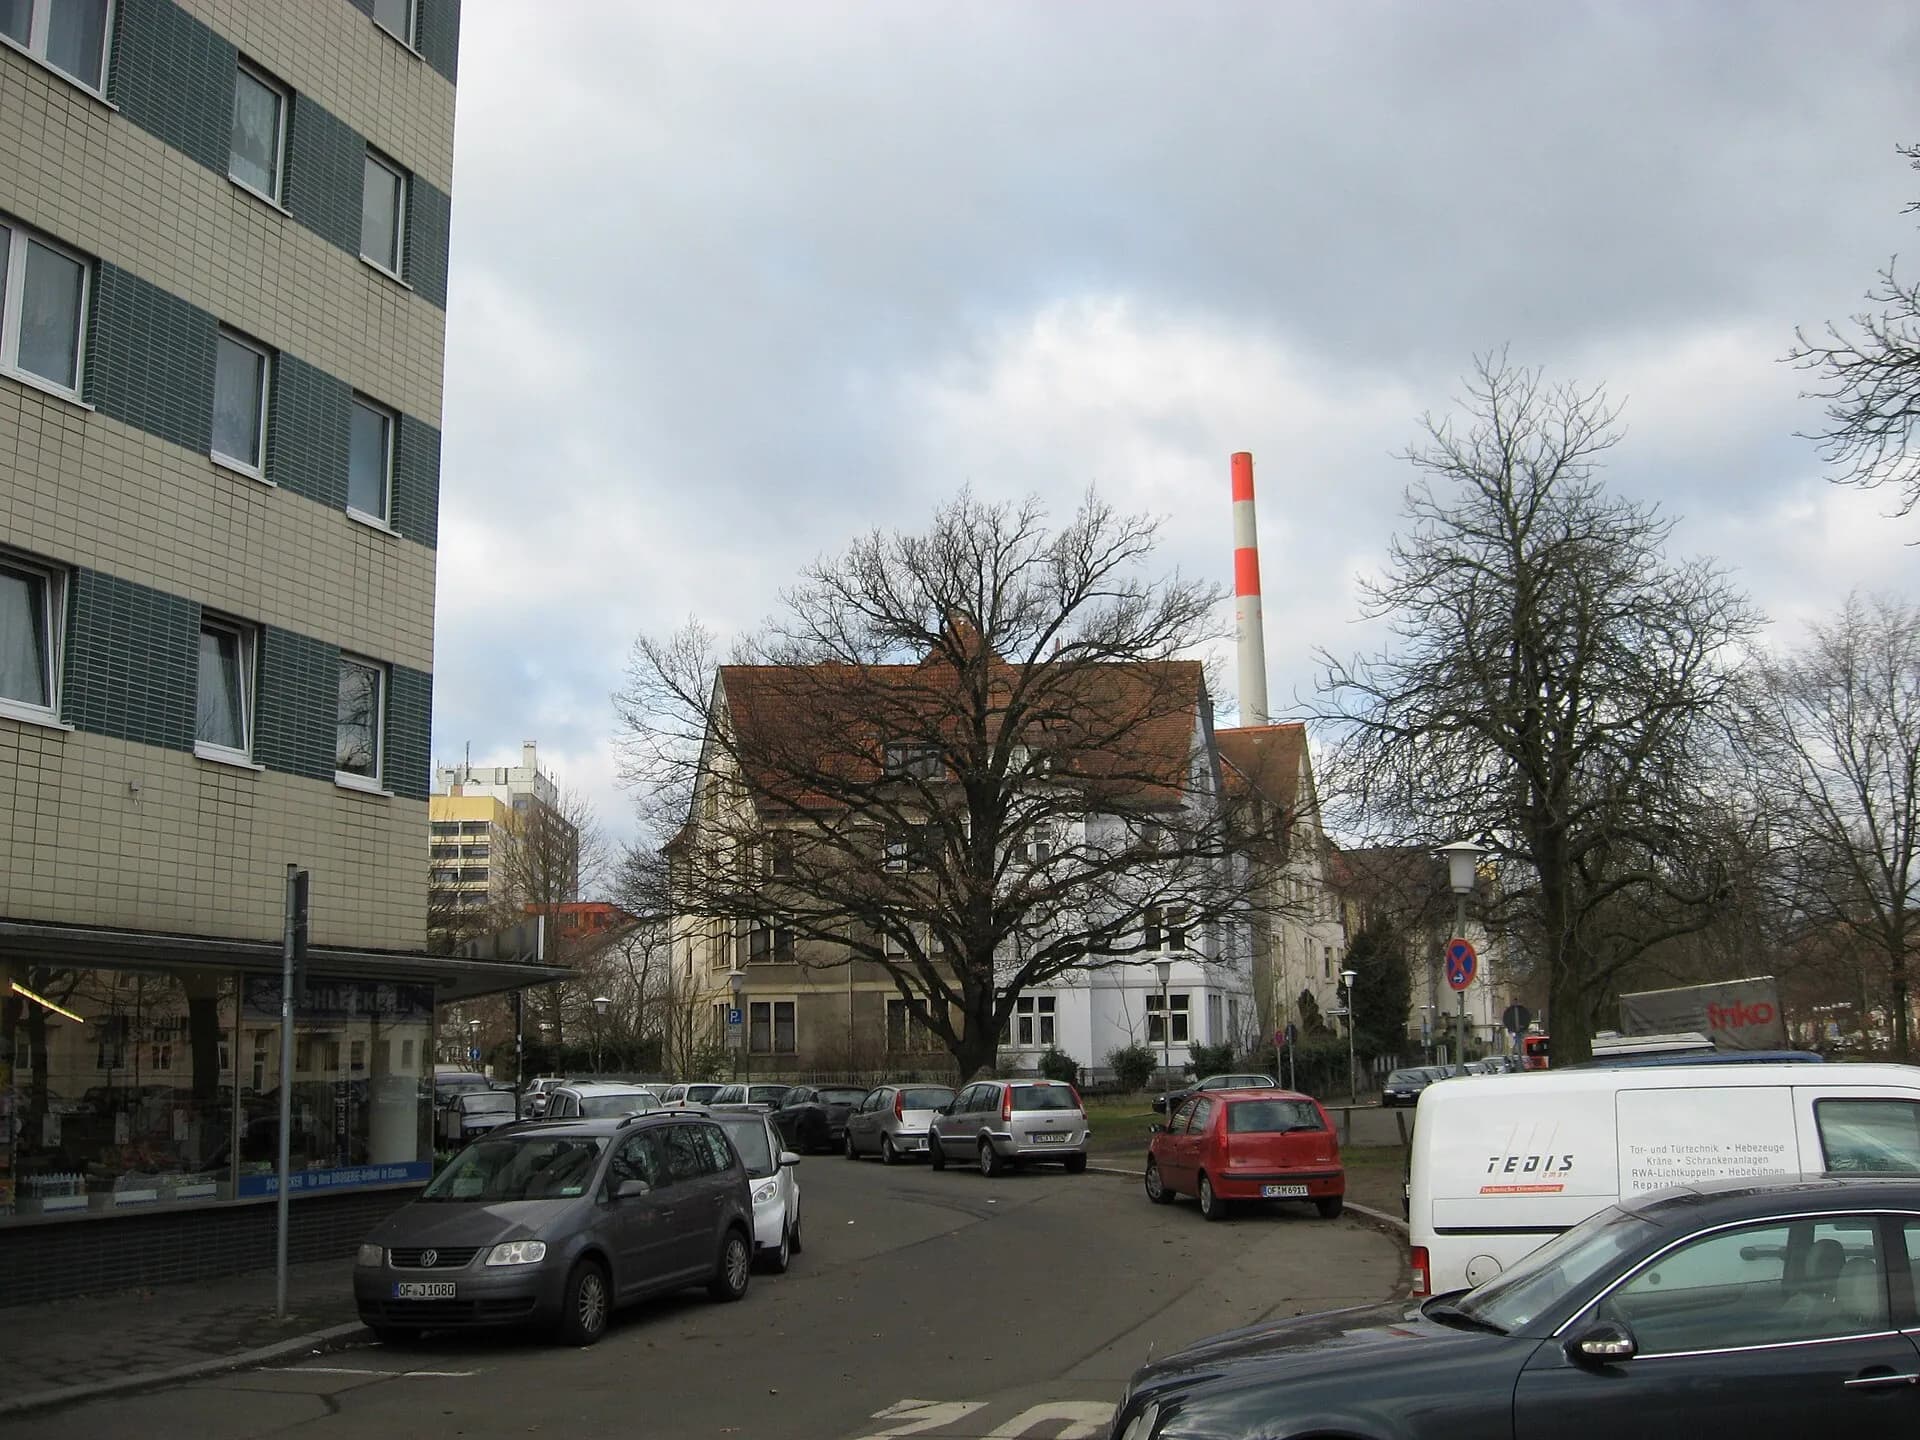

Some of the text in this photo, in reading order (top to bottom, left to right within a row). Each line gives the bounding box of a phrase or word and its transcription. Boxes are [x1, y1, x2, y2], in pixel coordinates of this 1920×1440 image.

[730, 1010, 739, 1023] P
[1650, 1145, 1667, 1154] und
[1735, 1144, 1785, 1153] Hebezeuge
[1487, 1154, 1573, 1173] TEDIS
[1685, 1156, 1769, 1166] Schrankenanlagen
